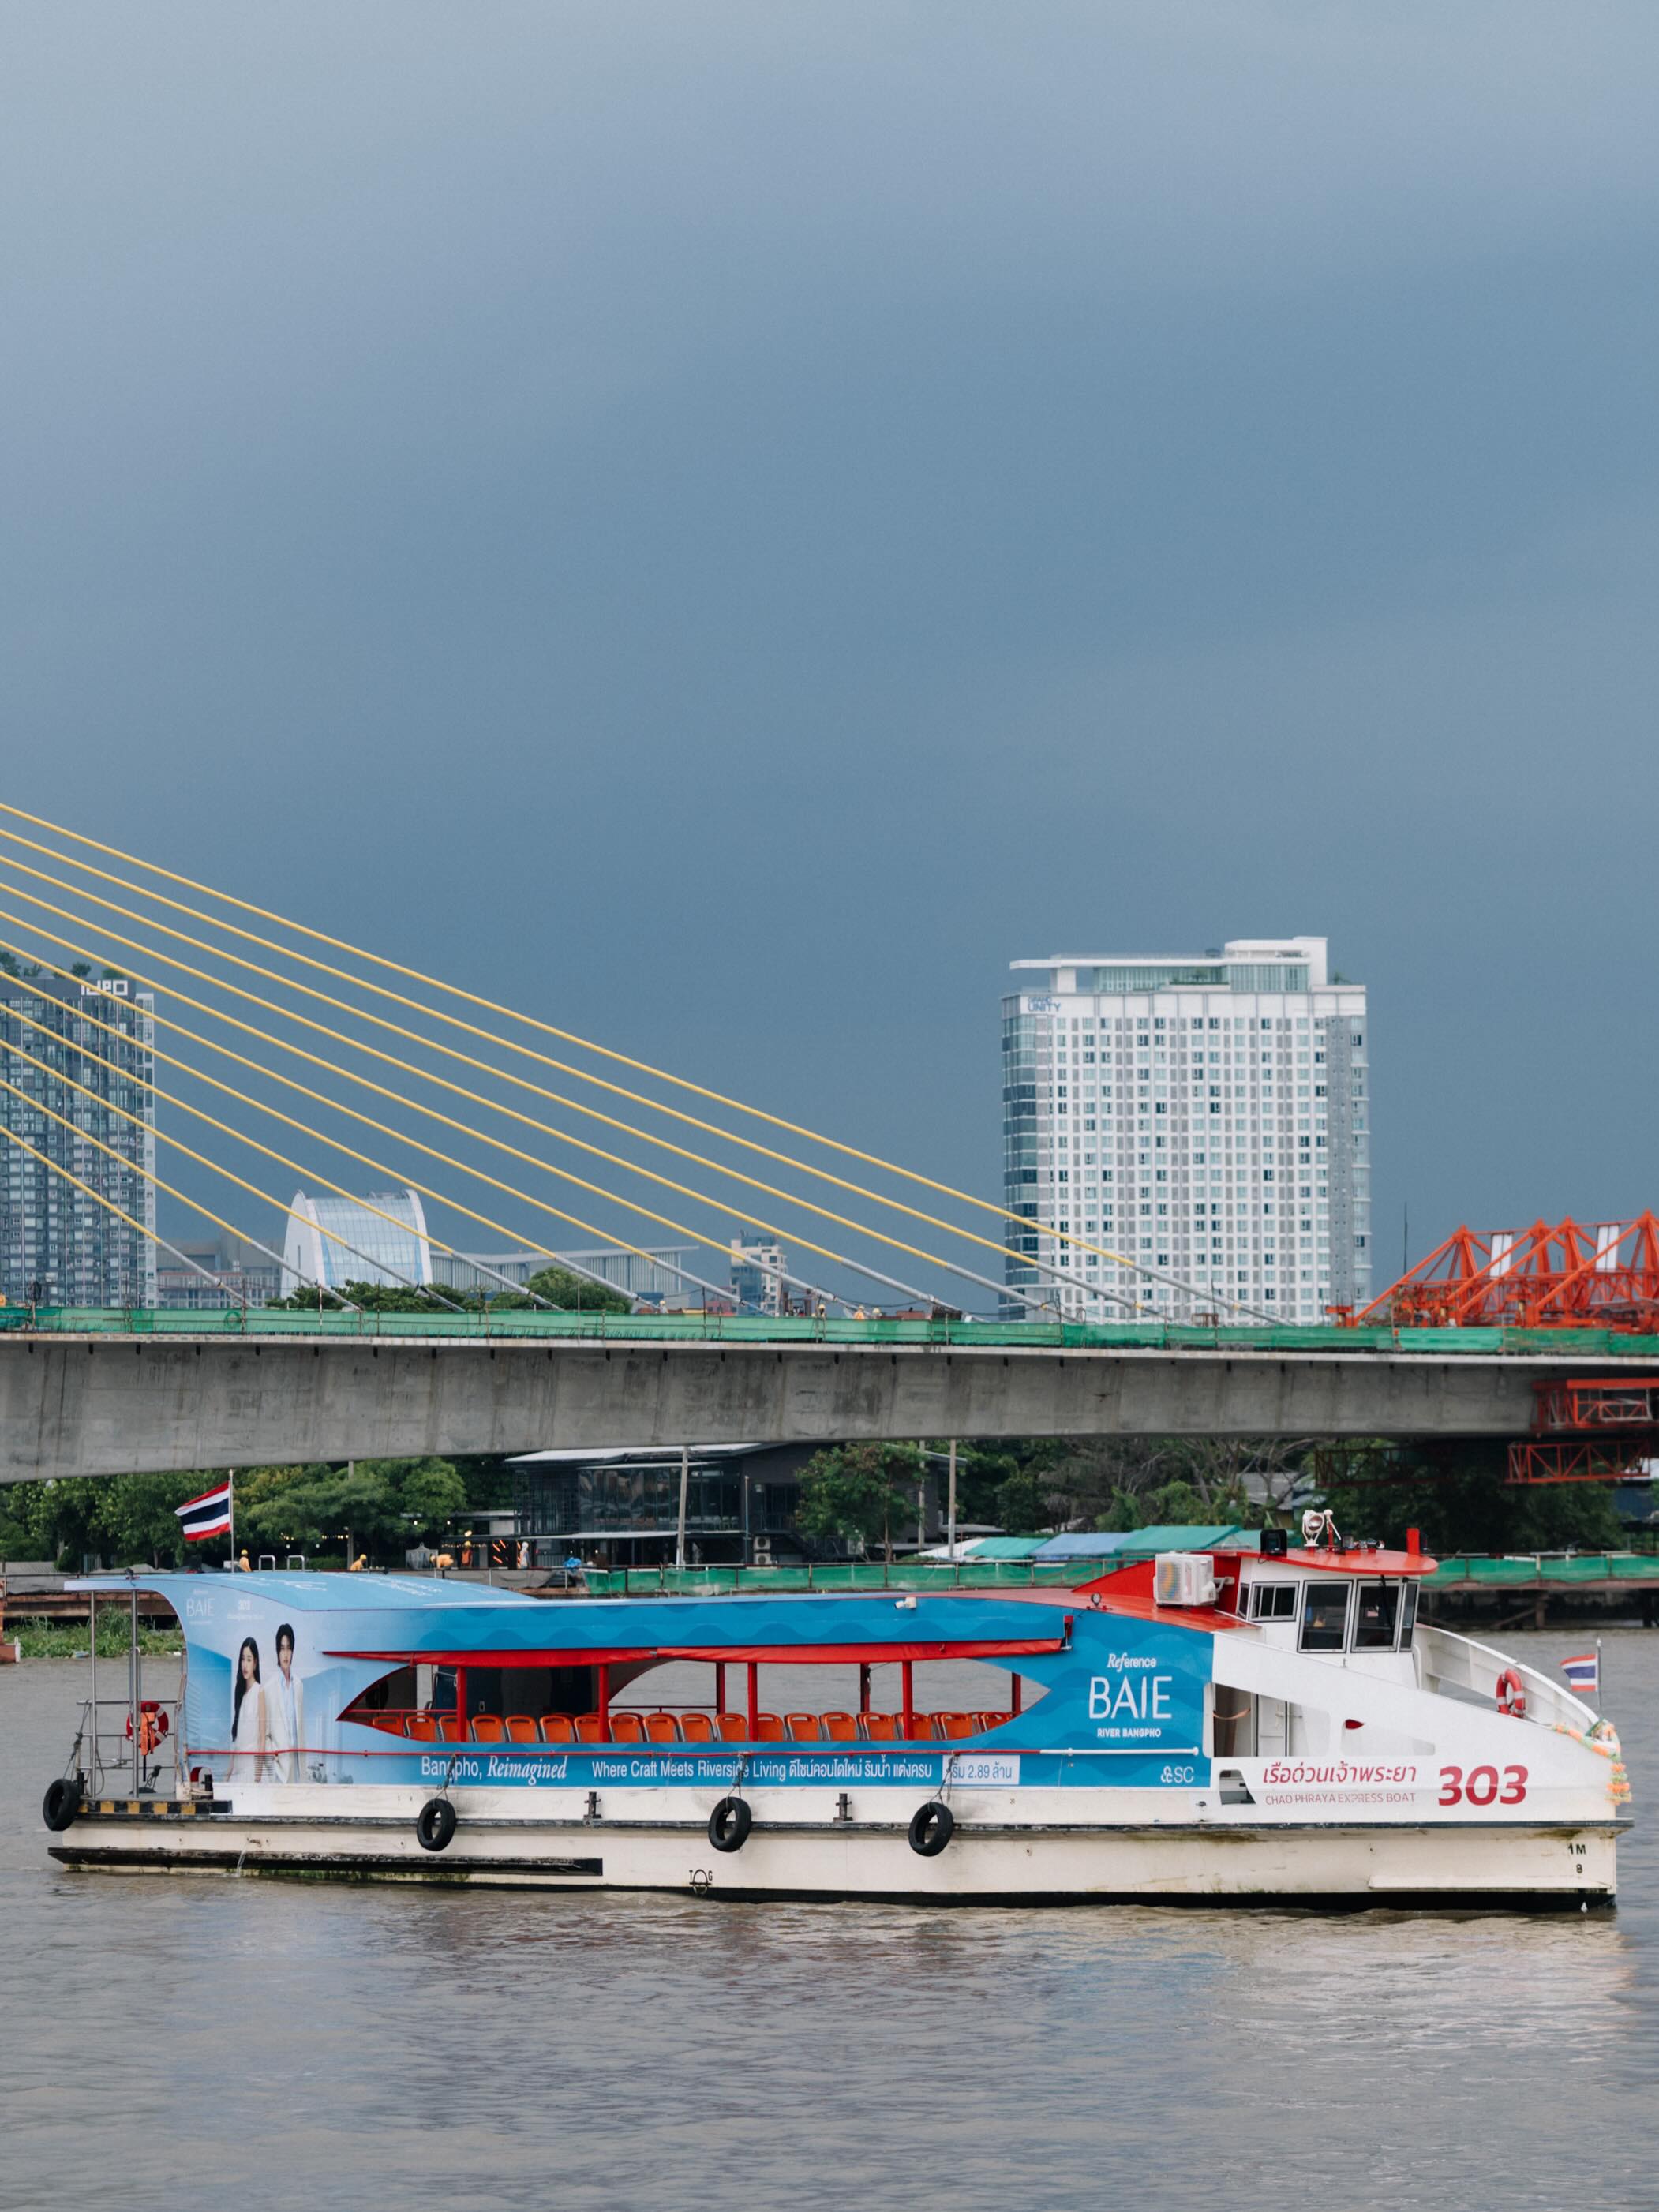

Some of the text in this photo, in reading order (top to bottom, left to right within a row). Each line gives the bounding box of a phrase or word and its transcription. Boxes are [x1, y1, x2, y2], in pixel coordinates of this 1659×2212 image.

[1028, 1003, 1061, 1012] UNITY
[186, 1597, 215, 1616] BAIE
[1107, 1652, 1157, 1672] Reference
[1088, 1676, 1173, 1720] BAIE
[1097, 1728, 1161, 1738] RIVER BANGPHO
[486, 1755, 568, 1786] Reimagined
[592, 1761, 627, 1777] Where
[631, 1761, 657, 1777] Craft
[661, 1761, 694, 1777] Meets
[753, 1761, 786, 1782] Living
[893, 1758, 932, 1778] แต่งครบ
[968, 1764, 990, 1779] 2.89
[992, 1761, 1012, 1779] ล้าน
[1174, 1766, 1194, 1783] SC
[1263, 1761, 1417, 1783] เรือด่วนเจ้าพระยา
[1438, 1765, 1530, 1806] 303
[1265, 1792, 1416, 1806] CHAO PHRAYA EXPRESS BOAT
